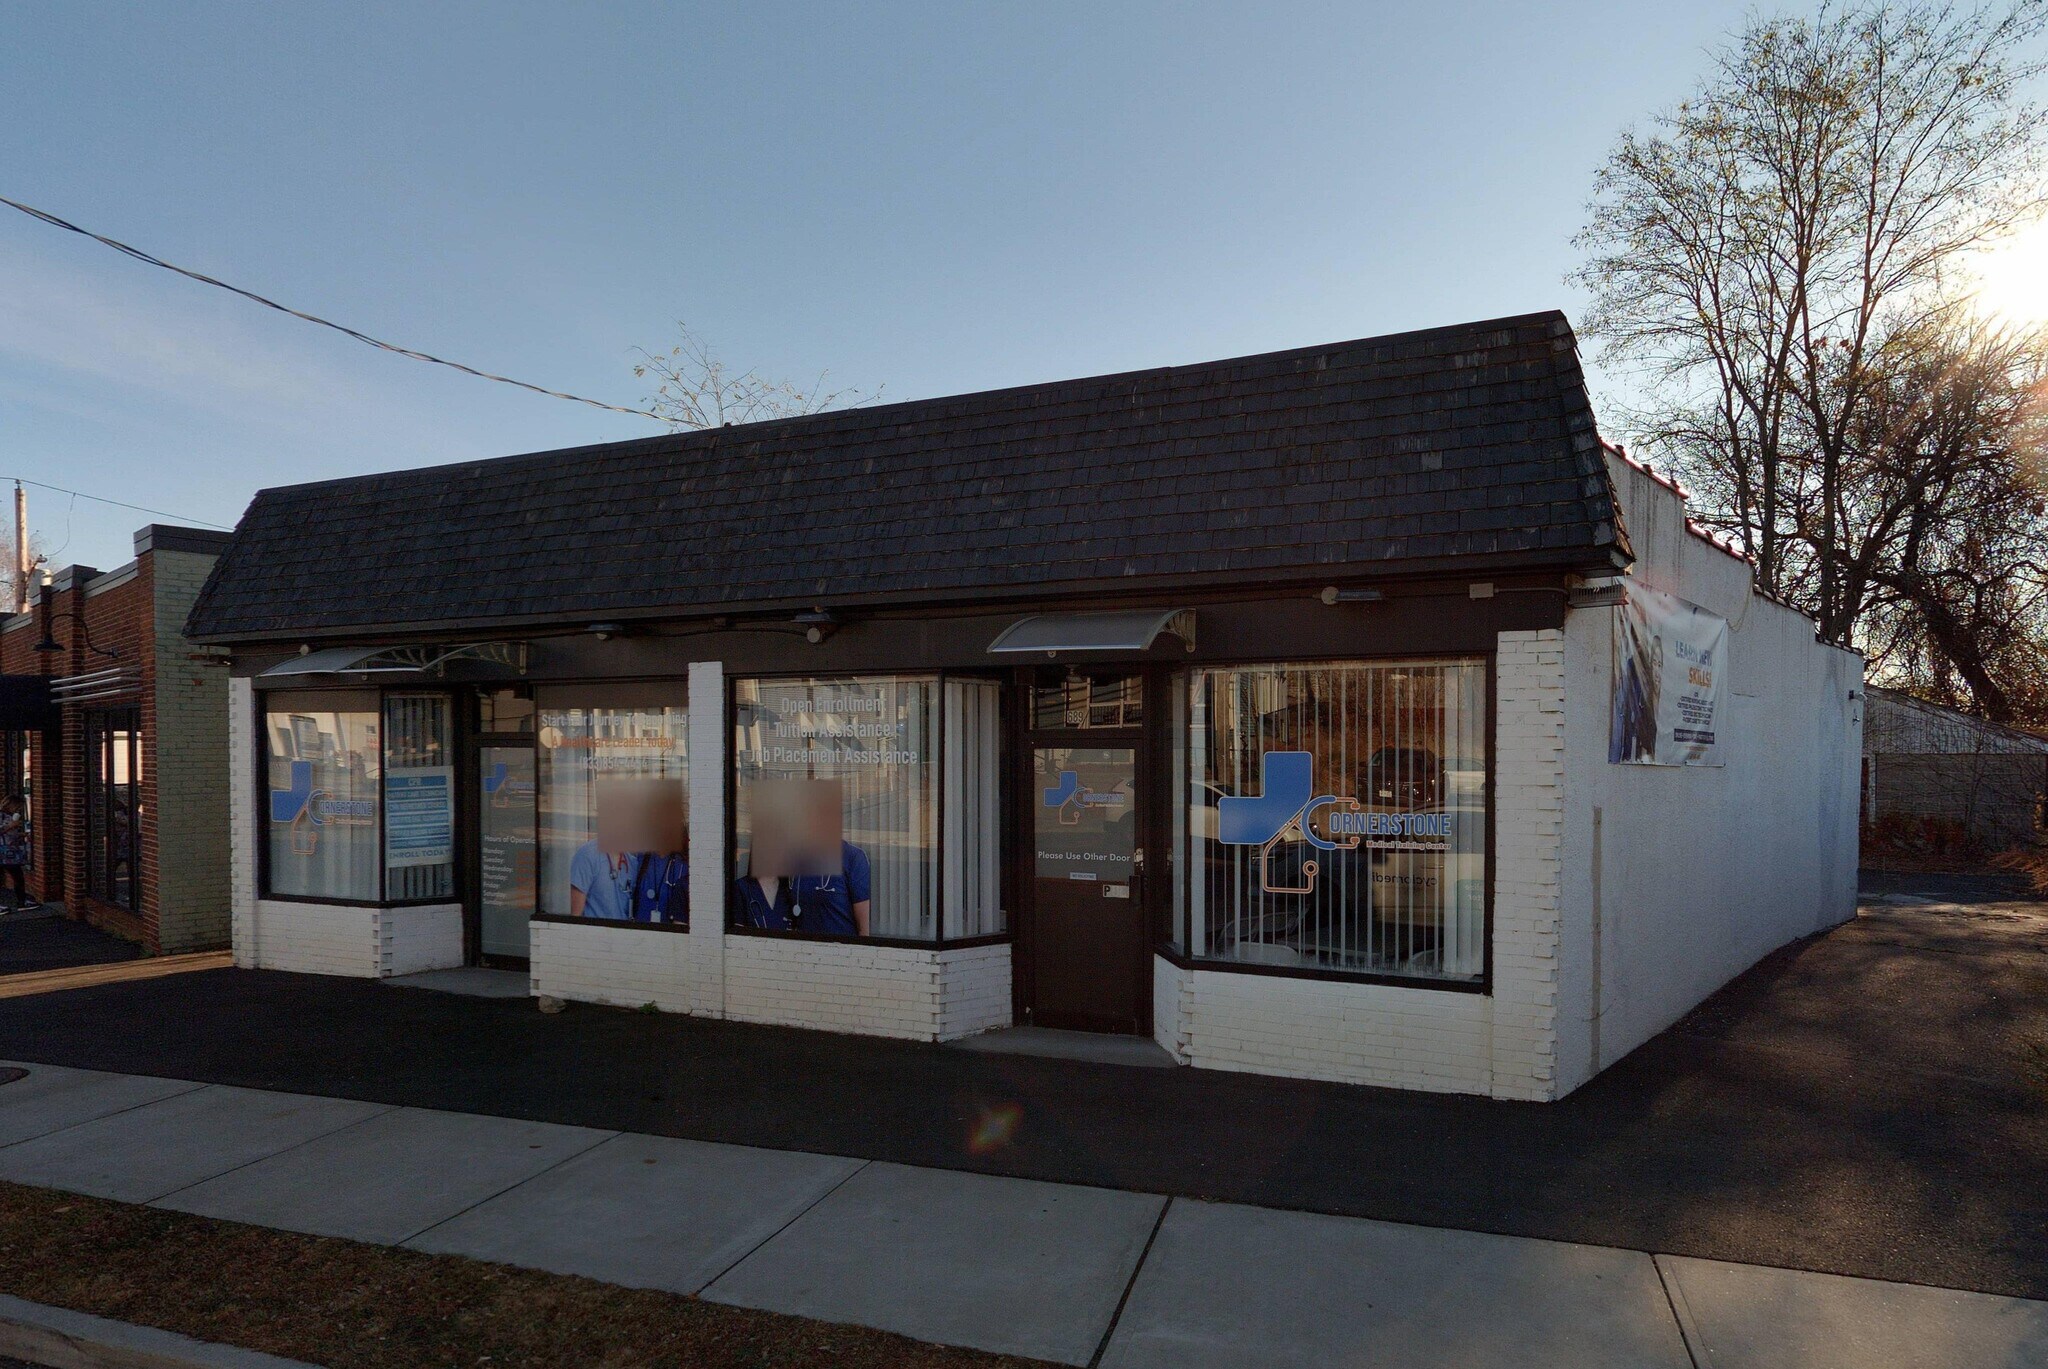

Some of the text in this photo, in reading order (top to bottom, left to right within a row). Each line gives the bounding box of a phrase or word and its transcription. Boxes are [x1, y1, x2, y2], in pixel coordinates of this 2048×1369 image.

[782, 697, 886, 715] Open Enrollment
[541, 713, 565, 727] Start
[774, 721, 891, 738] Tuition Assistance
[773, 746, 841, 763] Placement
[844, 748, 918, 765] Assistance
[503, 835, 510, 843] of
[1366, 840, 1451, 851] Medical Training Center
[1038, 850, 1131, 862] Please Use Other Door
